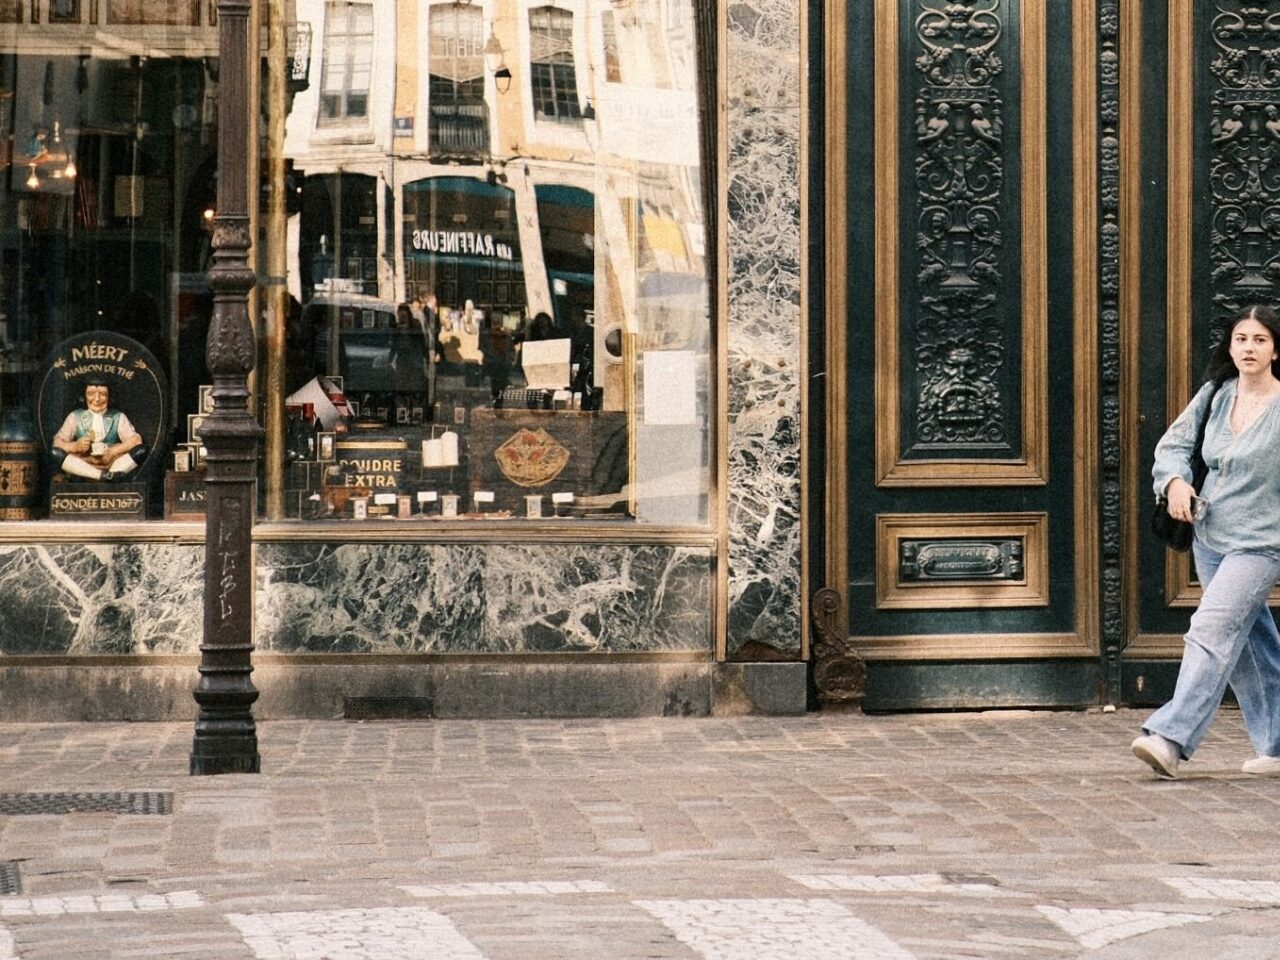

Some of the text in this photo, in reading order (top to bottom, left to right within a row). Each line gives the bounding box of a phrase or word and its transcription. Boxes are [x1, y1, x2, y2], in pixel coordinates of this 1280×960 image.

[71, 341, 129, 362] MÉERT
[63, 363, 104, 381] MAISON
[103, 363, 117, 375] DE
[345, 474, 398, 488] EXTRA
[55, 496, 140, 511] FONDÉE EN 1677
[178, 491, 206, 503] JAS
